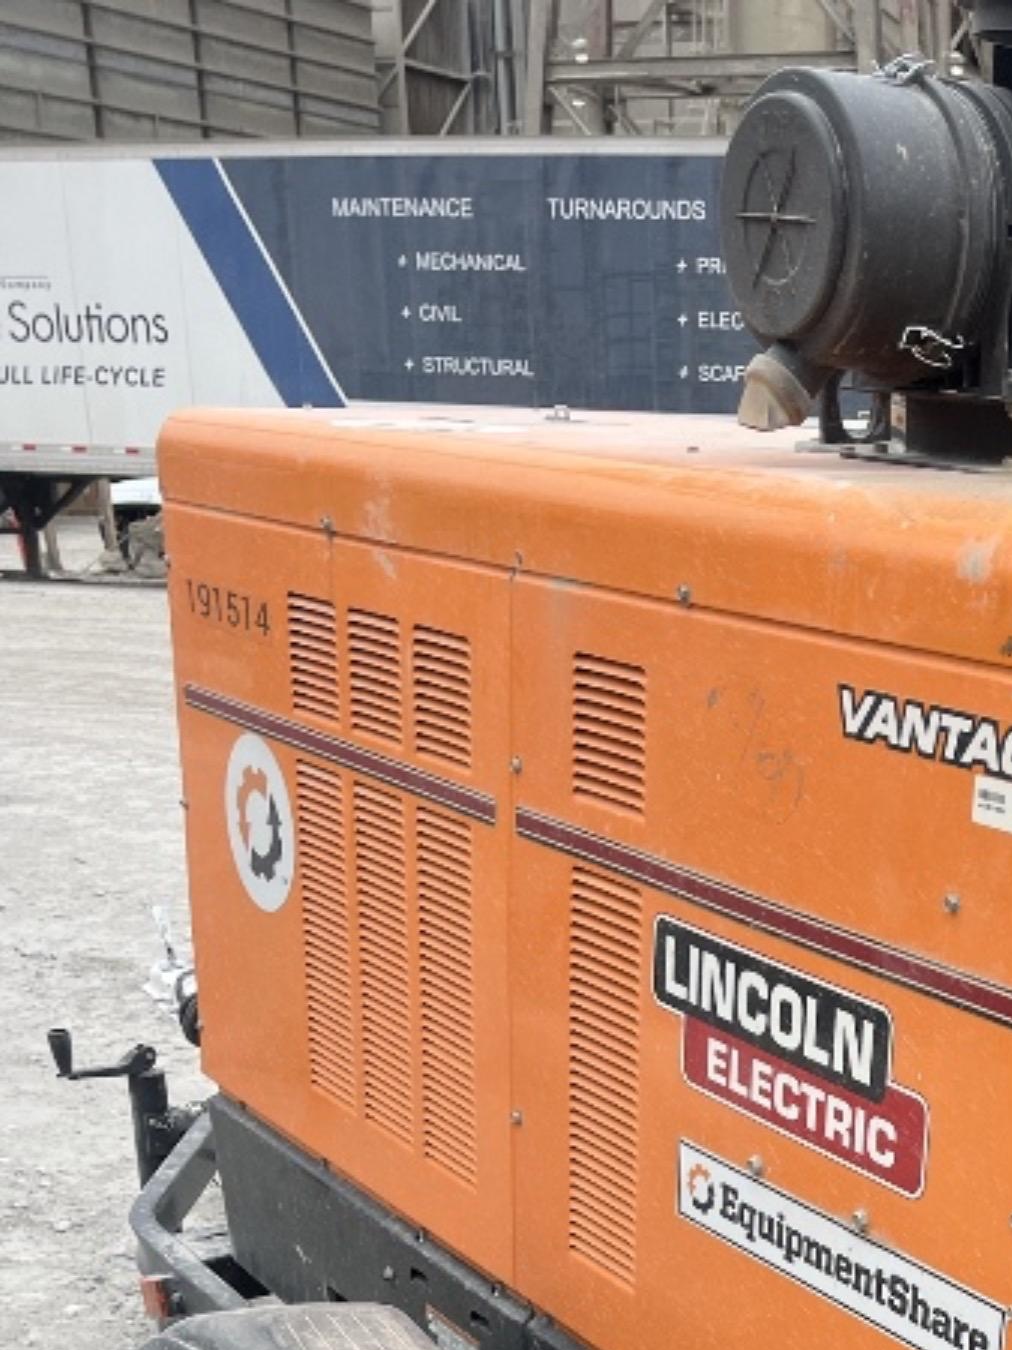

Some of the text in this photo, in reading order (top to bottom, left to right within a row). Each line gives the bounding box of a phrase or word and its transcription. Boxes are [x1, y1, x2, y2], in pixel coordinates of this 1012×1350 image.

[331, 197, 474, 219] MAINTENANCE
[547, 197, 707, 221] TURNAROUNDS
[415, 251, 527, 272] MECHANICAL
[8, 300, 169, 343] Solutions
[418, 303, 463, 322] CIVIL
[41, 365, 166, 387] LIFE-CYCLE
[421, 356, 536, 377] STRUCTURAL
[186, 578, 270, 637] 191514
[662, 935, 876, 1088] LINCOLN
[705, 1038, 898, 1170] ELECTRIC
